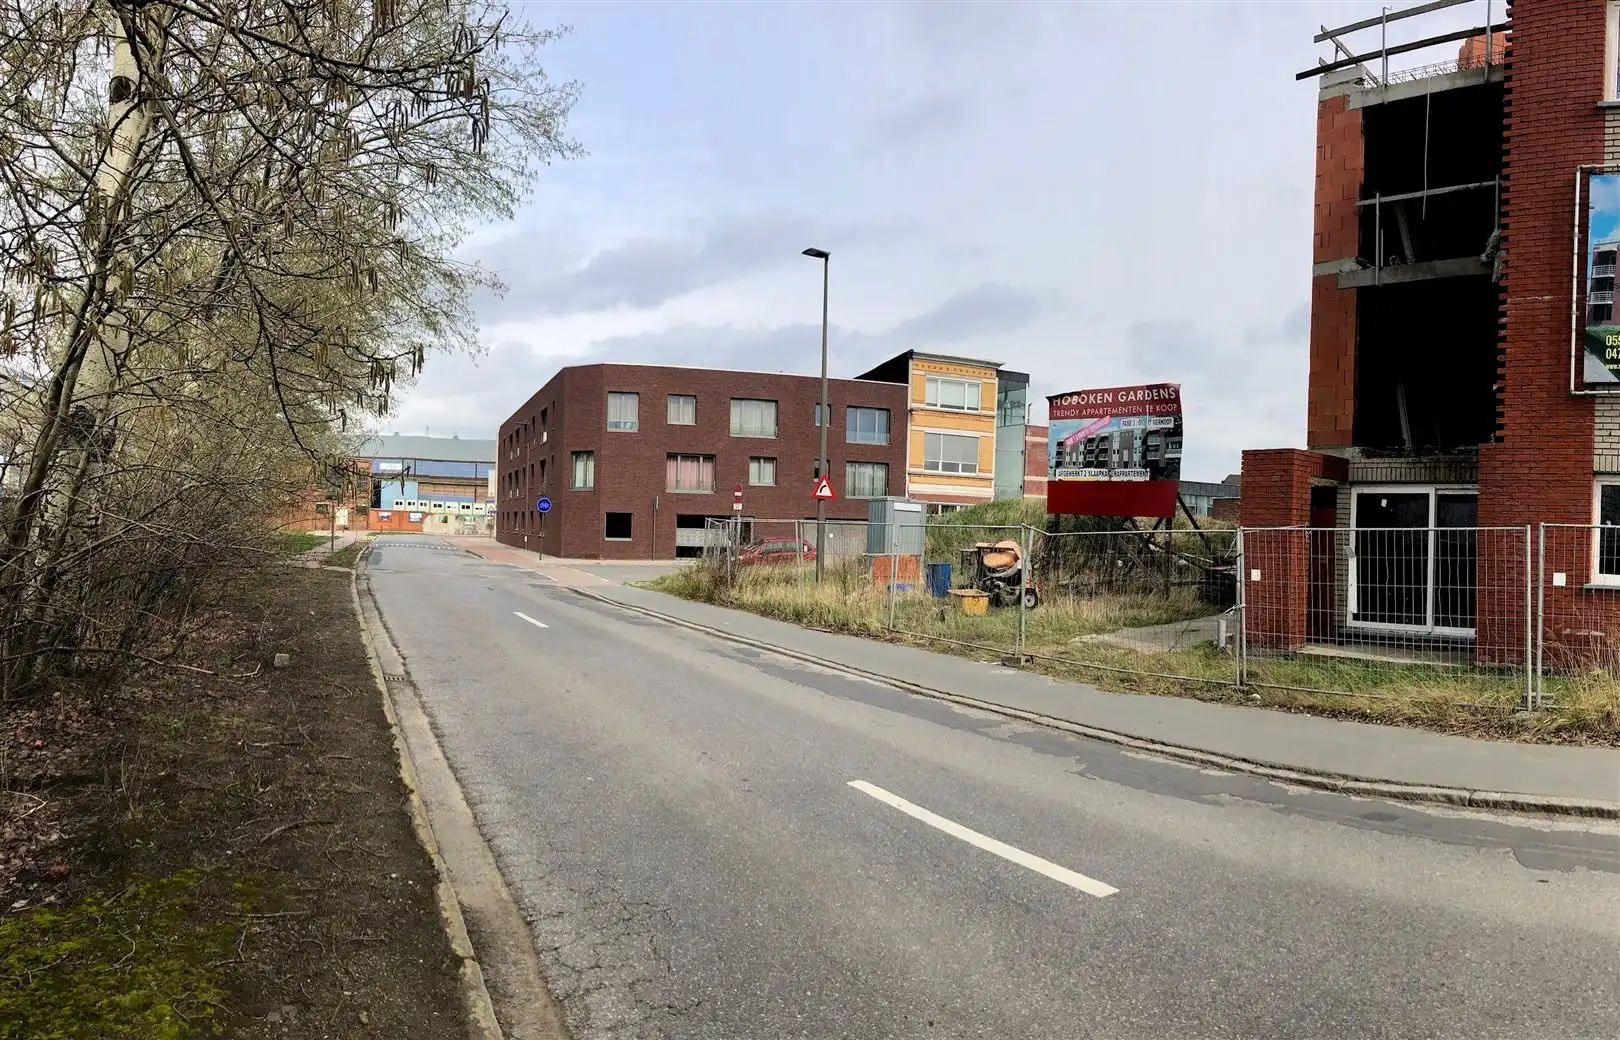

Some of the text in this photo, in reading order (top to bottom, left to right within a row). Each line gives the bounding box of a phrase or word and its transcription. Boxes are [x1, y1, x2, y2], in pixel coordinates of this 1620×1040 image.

[1053, 387, 1176, 406] HOBOKEN GARDENS
[1053, 403, 1178, 417] TRENDY APPARTEMENTEN TE KOOP
